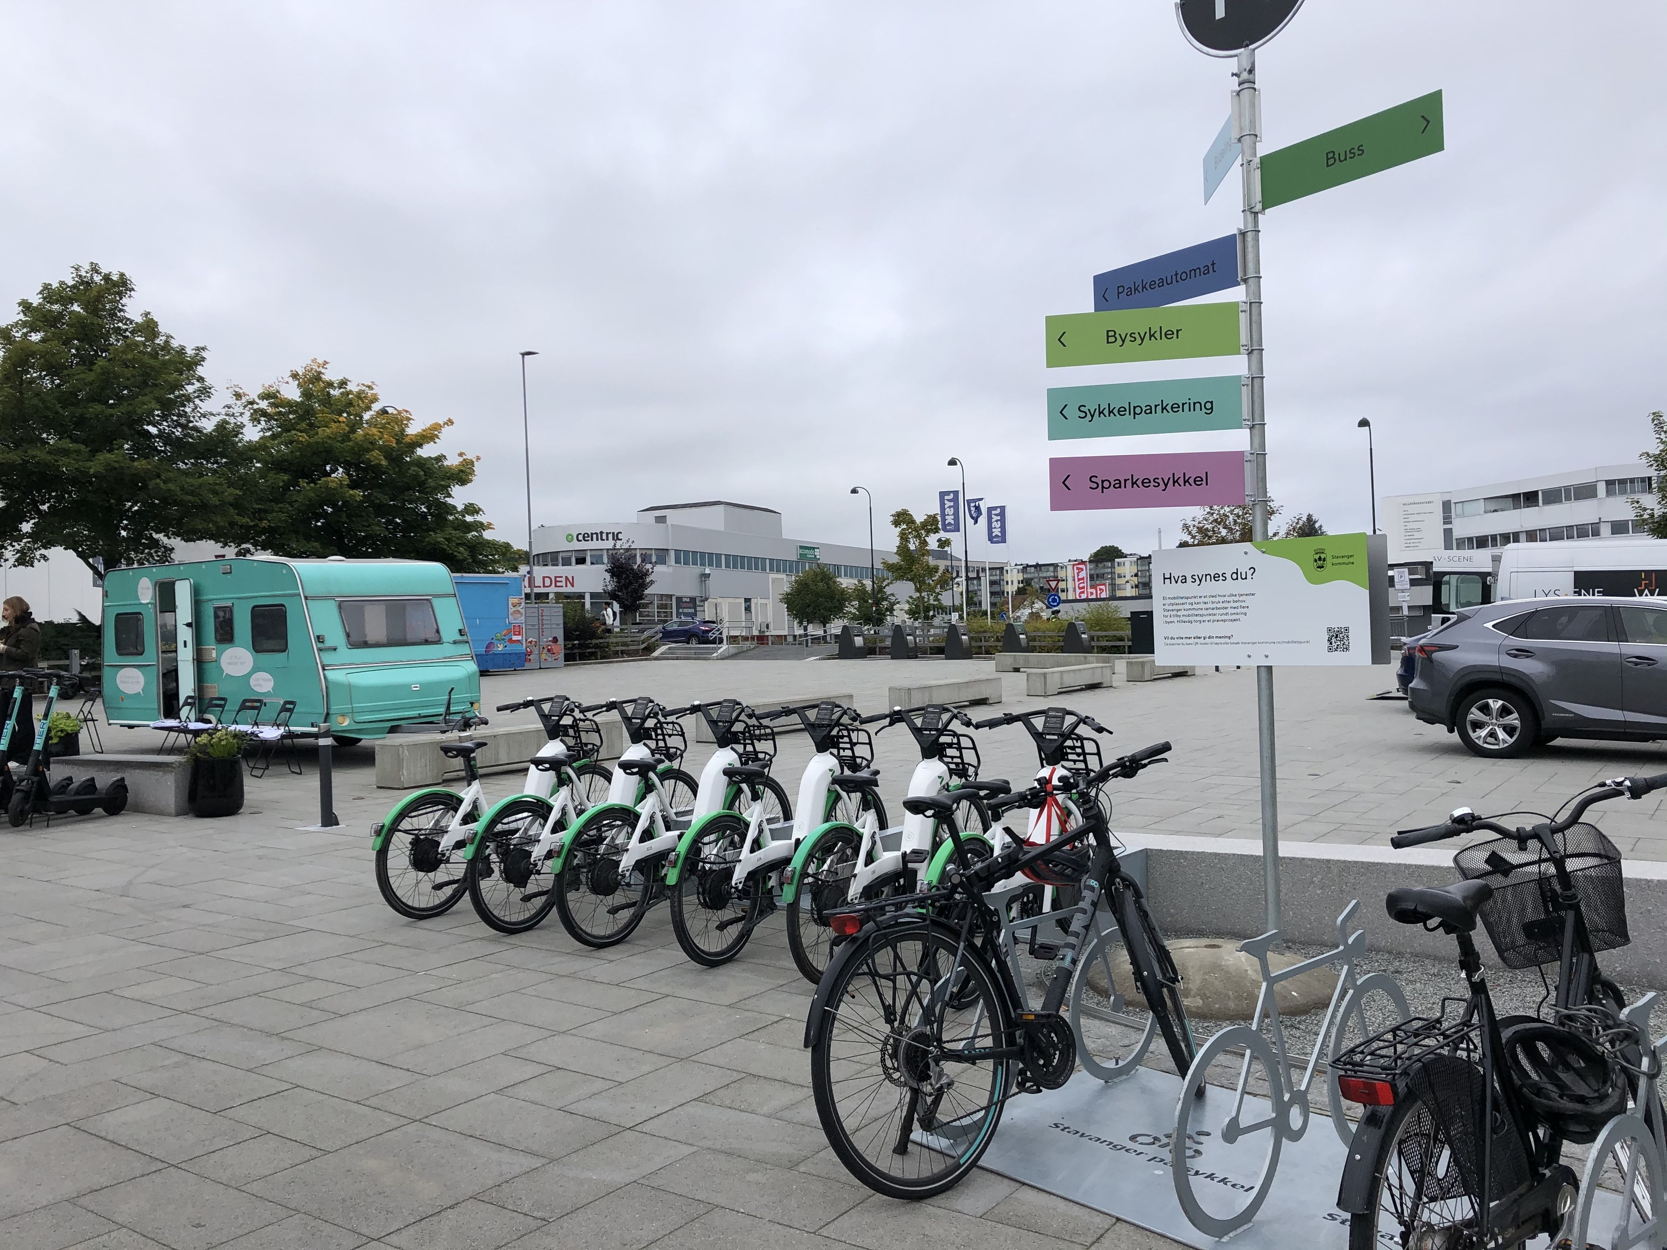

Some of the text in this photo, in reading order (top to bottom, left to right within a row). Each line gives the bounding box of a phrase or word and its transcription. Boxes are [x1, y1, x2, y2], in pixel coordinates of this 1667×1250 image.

[1326, 144, 1365, 168] Buss
[1116, 260, 1216, 299] Pakkeautomat
[1106, 326, 1182, 347] Bysykler
[1077, 398, 1214, 422] Sykkelparkering
[1089, 472, 1209, 493] Sparkesykkel
[576, 530, 622, 542] centric
[524, 576, 574, 588] ILDEN
[1163, 566, 1256, 586] Hva synes du?
[35, 722, 46, 744] TIER
